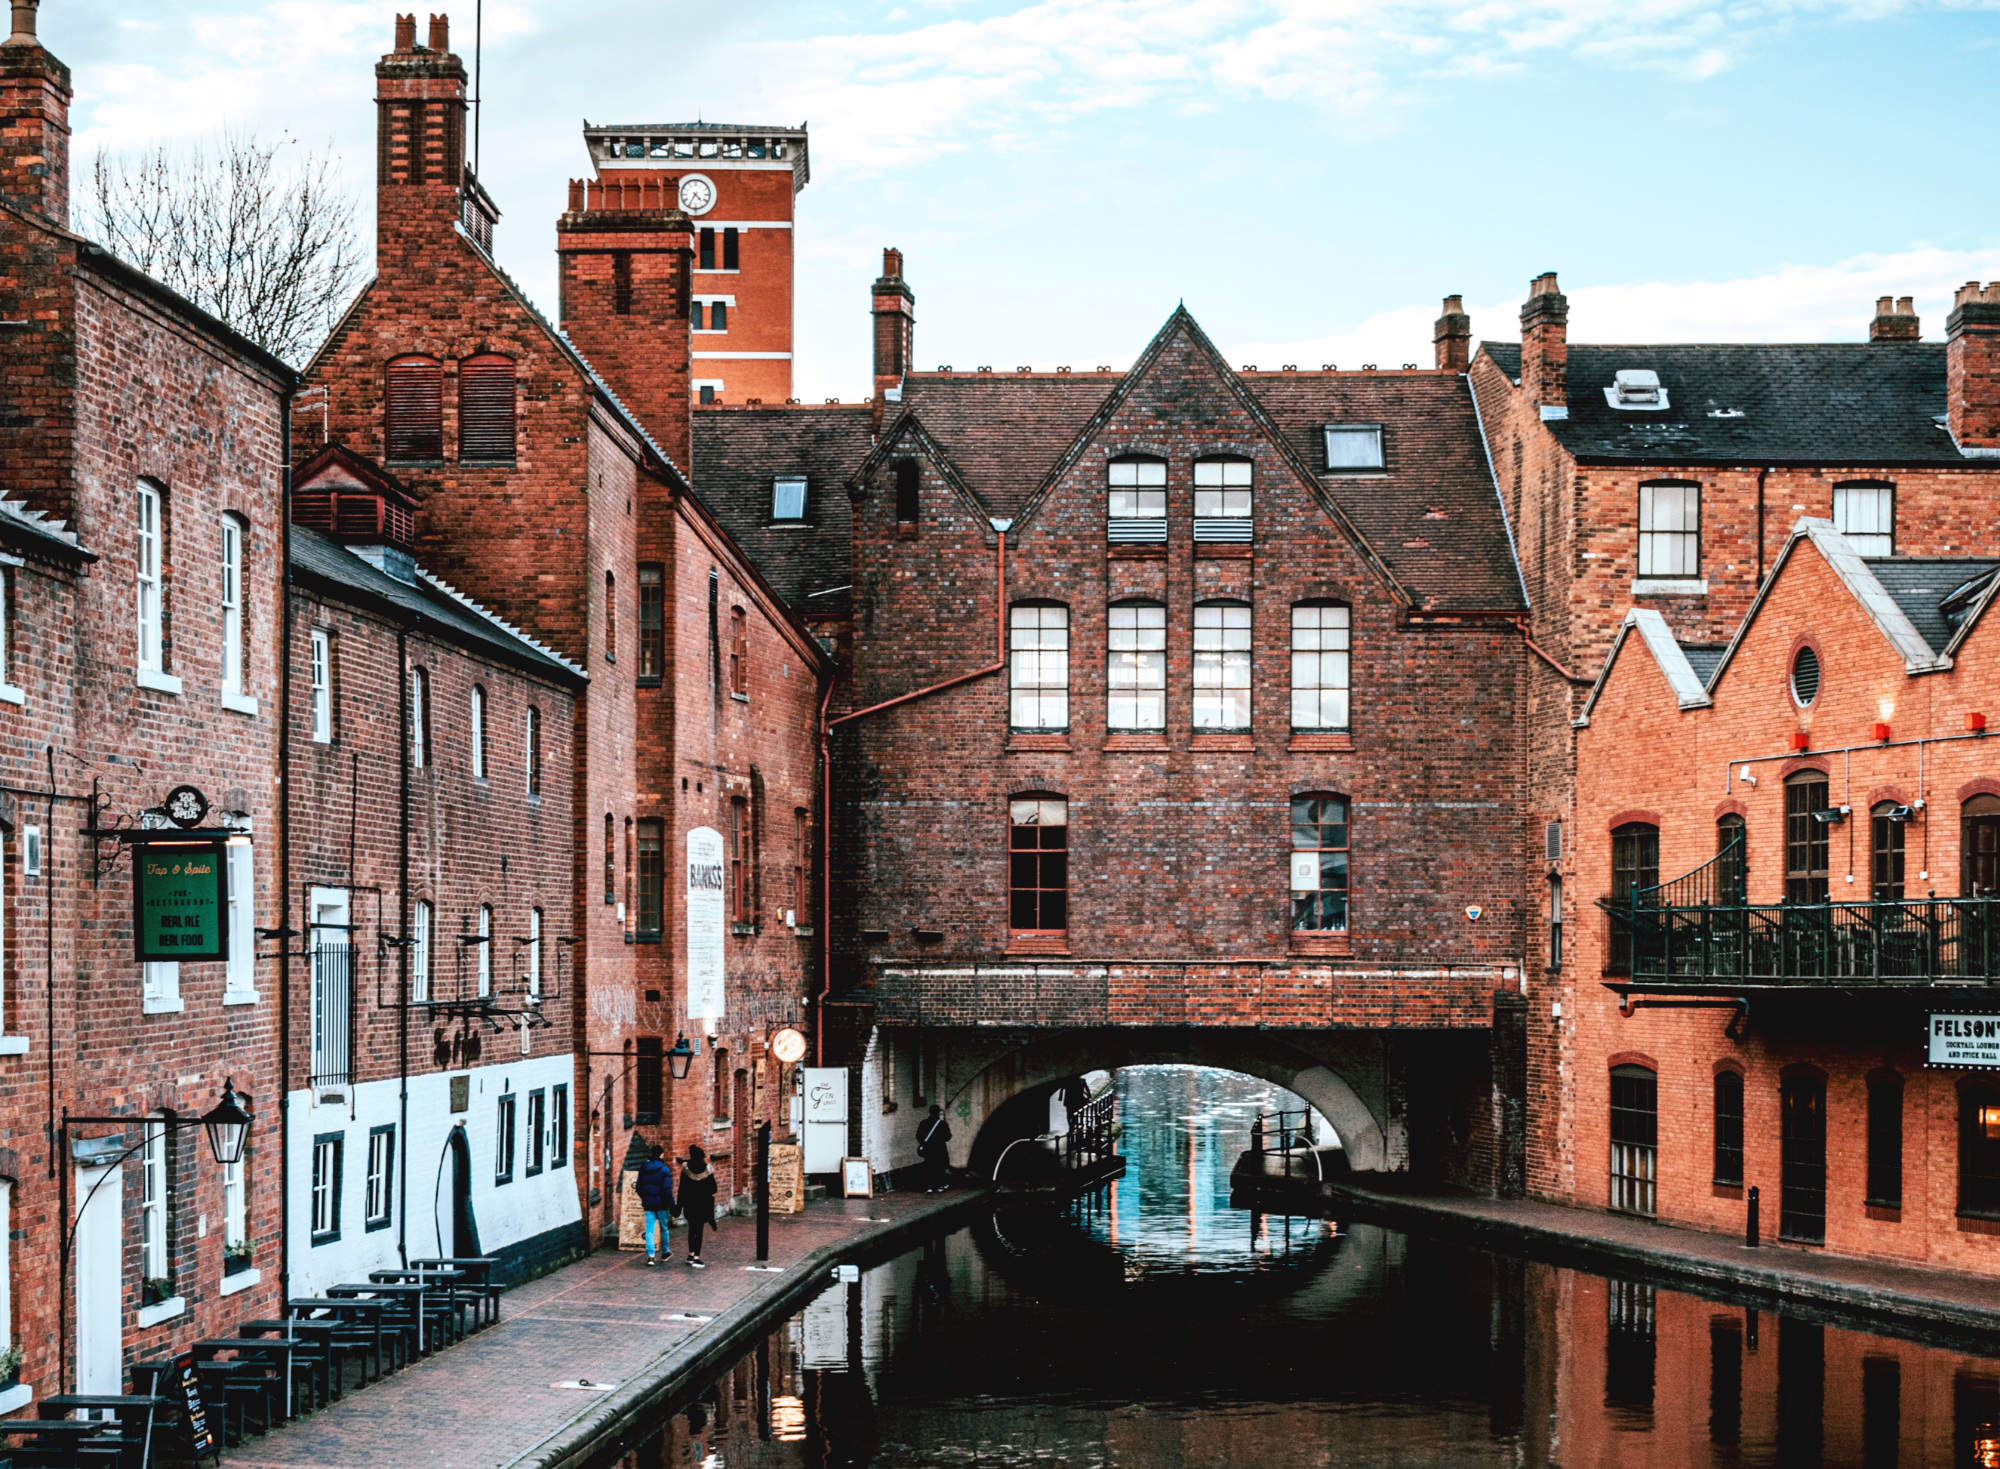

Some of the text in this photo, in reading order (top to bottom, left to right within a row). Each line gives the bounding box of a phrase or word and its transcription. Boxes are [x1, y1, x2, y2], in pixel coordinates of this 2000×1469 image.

[147, 864, 168, 876] Tap
[161, 915, 200, 928] REAL ALE
[159, 934, 203, 947] REAL FOOD
[1946, 1041, 1999, 1050] COCKTAIL LOUNGE
